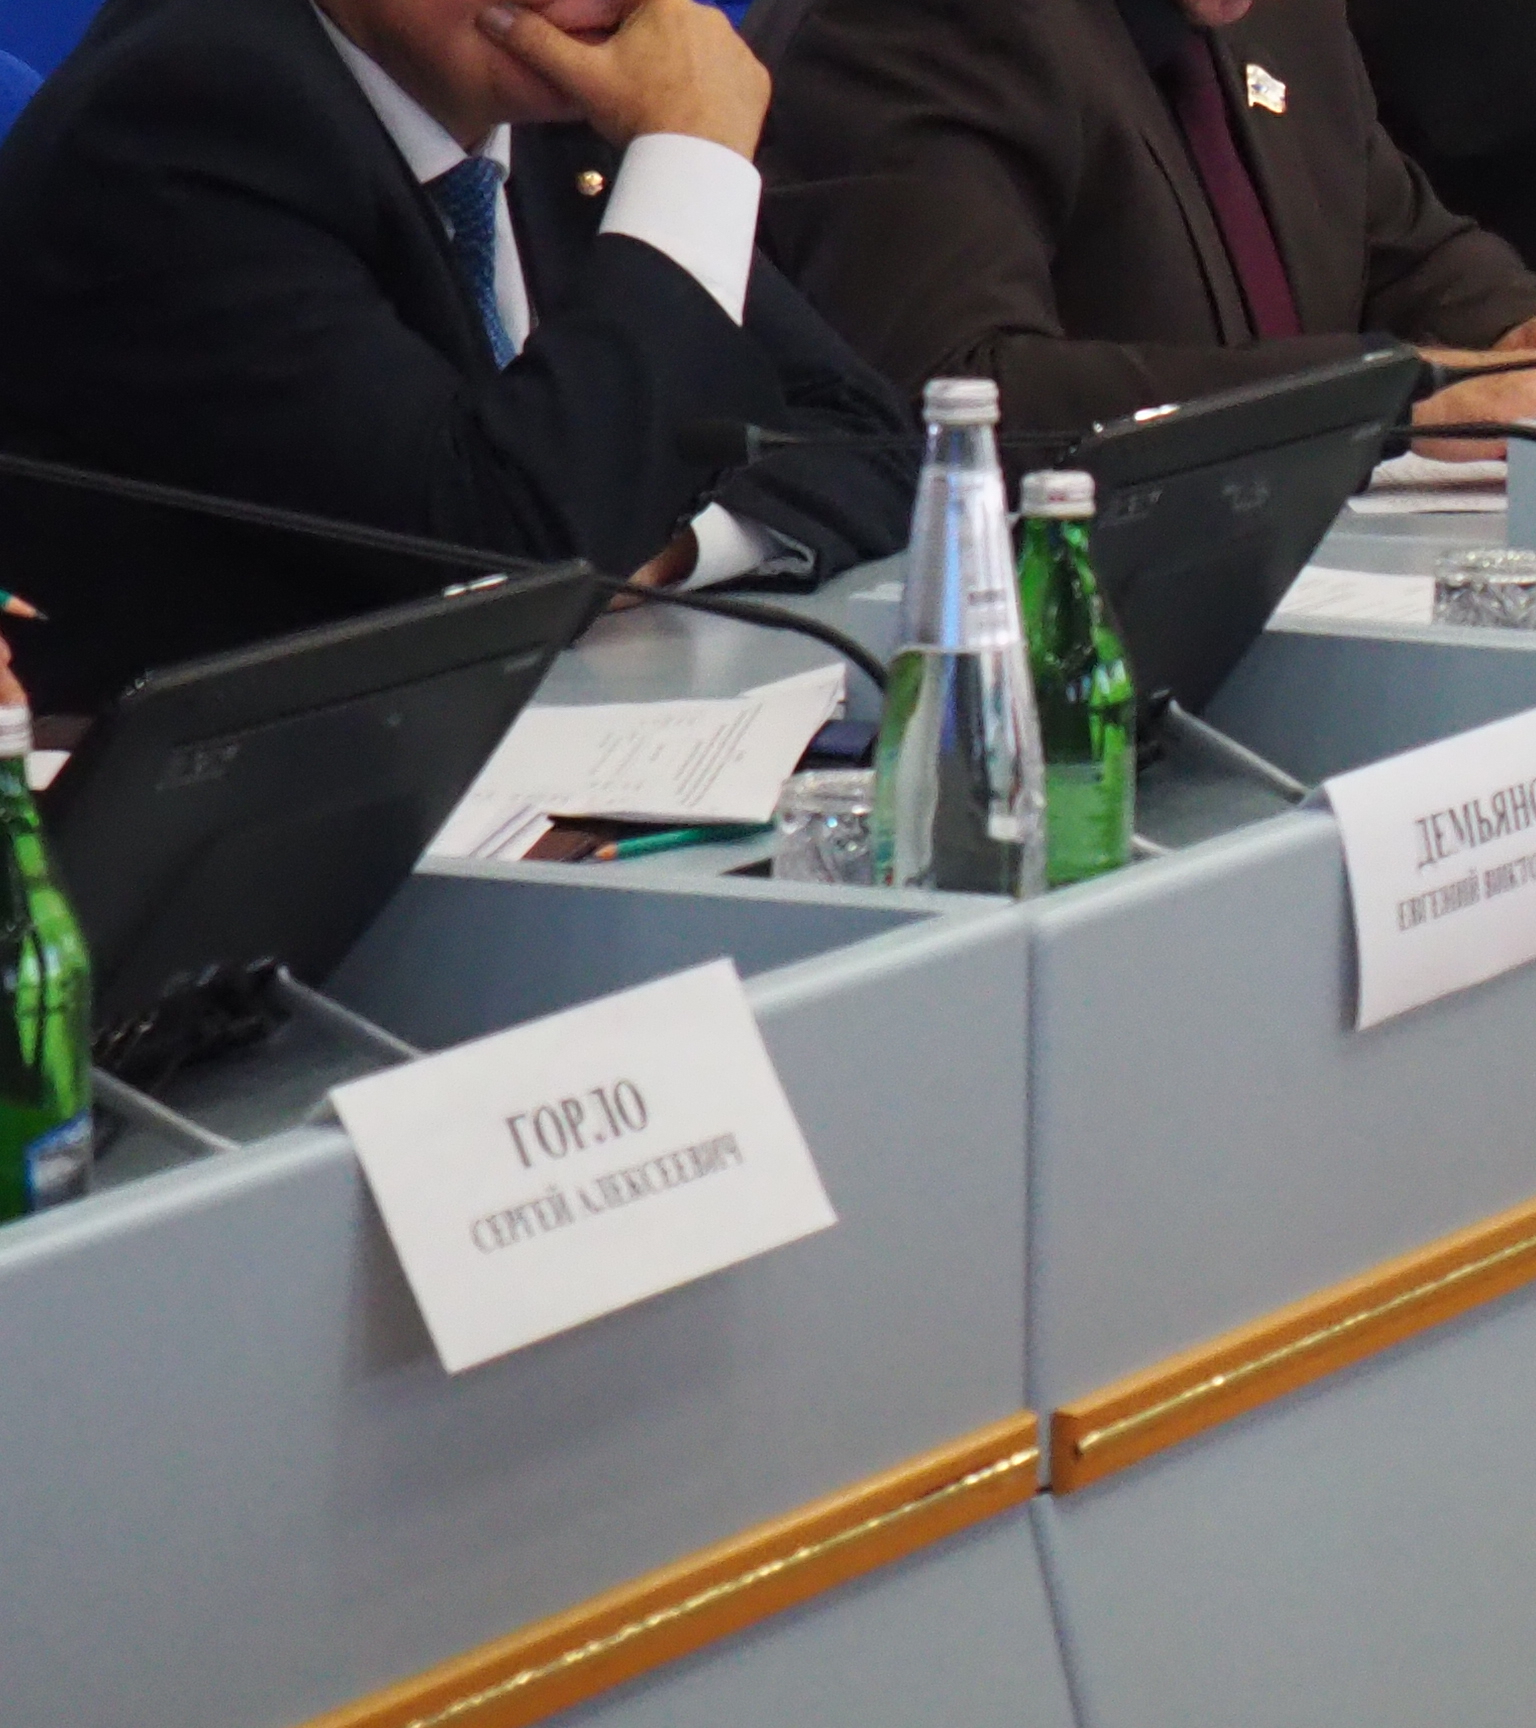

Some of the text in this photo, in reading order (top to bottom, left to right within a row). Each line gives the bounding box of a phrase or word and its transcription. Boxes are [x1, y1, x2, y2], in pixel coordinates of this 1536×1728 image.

[1397, 866, 1480, 932] ЕВГЕНИЙ
[506, 1077, 649, 1169] ГОРЛО
[469, 1131, 744, 1256] СЕРГЕЙ АЛЕКСЕЕВИЧ
